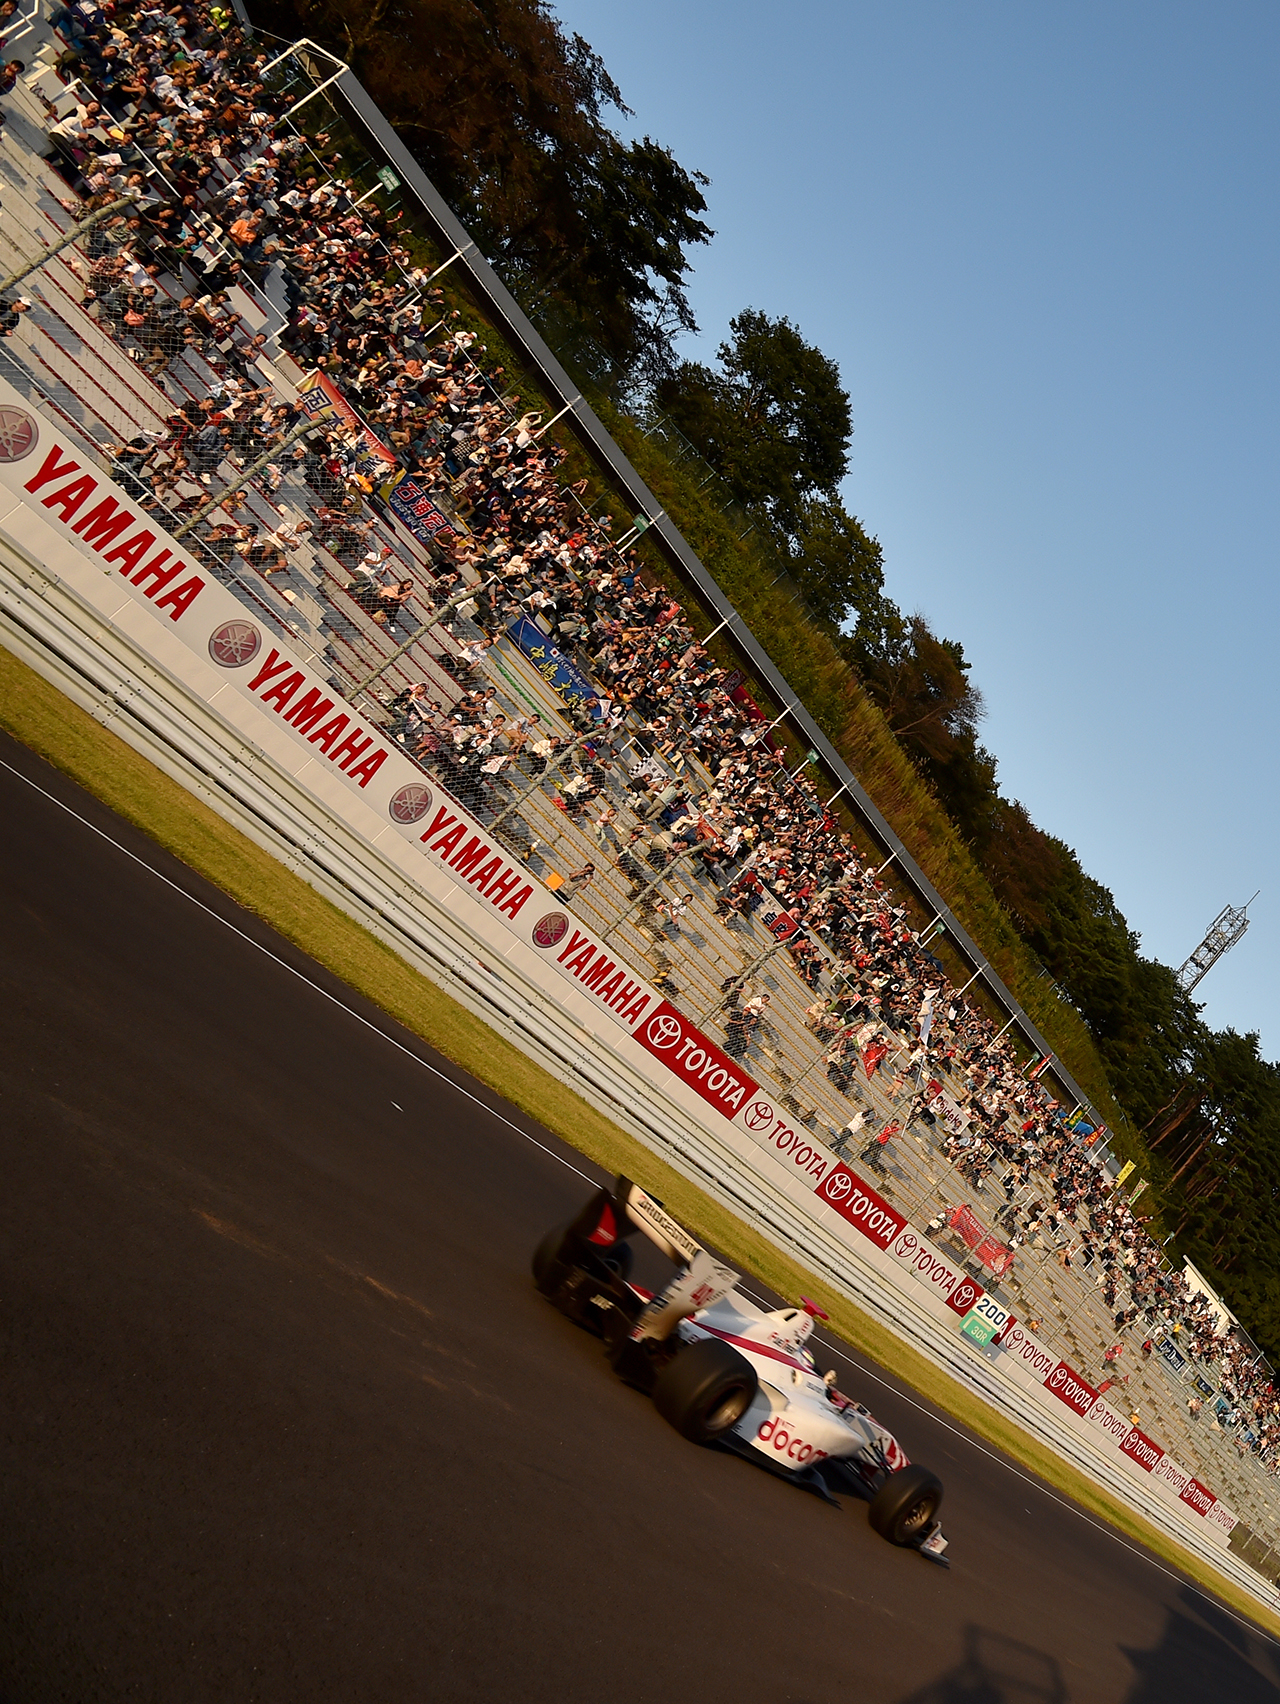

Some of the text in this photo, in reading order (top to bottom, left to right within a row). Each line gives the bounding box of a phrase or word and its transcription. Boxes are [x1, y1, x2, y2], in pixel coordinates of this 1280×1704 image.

[23, 444, 206, 621] YAMAHA
[247, 649, 390, 789] YAMAHA
[419, 805, 534, 920] YAMAHA
[556, 929, 652, 1026] YAMAHA
[674, 1036, 746, 1110] TOYOTA
[768, 1119, 828, 1181] TOYOTA
[845, 1188, 898, 1243] TOYOTA
[911, 1247, 957, 1294] TOYOTA
[976, 1297, 1007, 1327] 200
[970, 1325, 988, 1343] 30R
[1018, 1339, 1054, 1377] TOYOTA
[1061, 1377, 1093, 1411] TOYOTA
[757, 1416, 829, 1465] docom
[1100, 1411, 1128, 1441] TOYOTA
[1132, 1438, 1160, 1468] TOYOTA
[1163, 1466, 1188, 1491] TOYOTA
[1191, 1489, 1213, 1512] TOYOTA
[1215, 1510, 1236, 1531] TOYOTA
